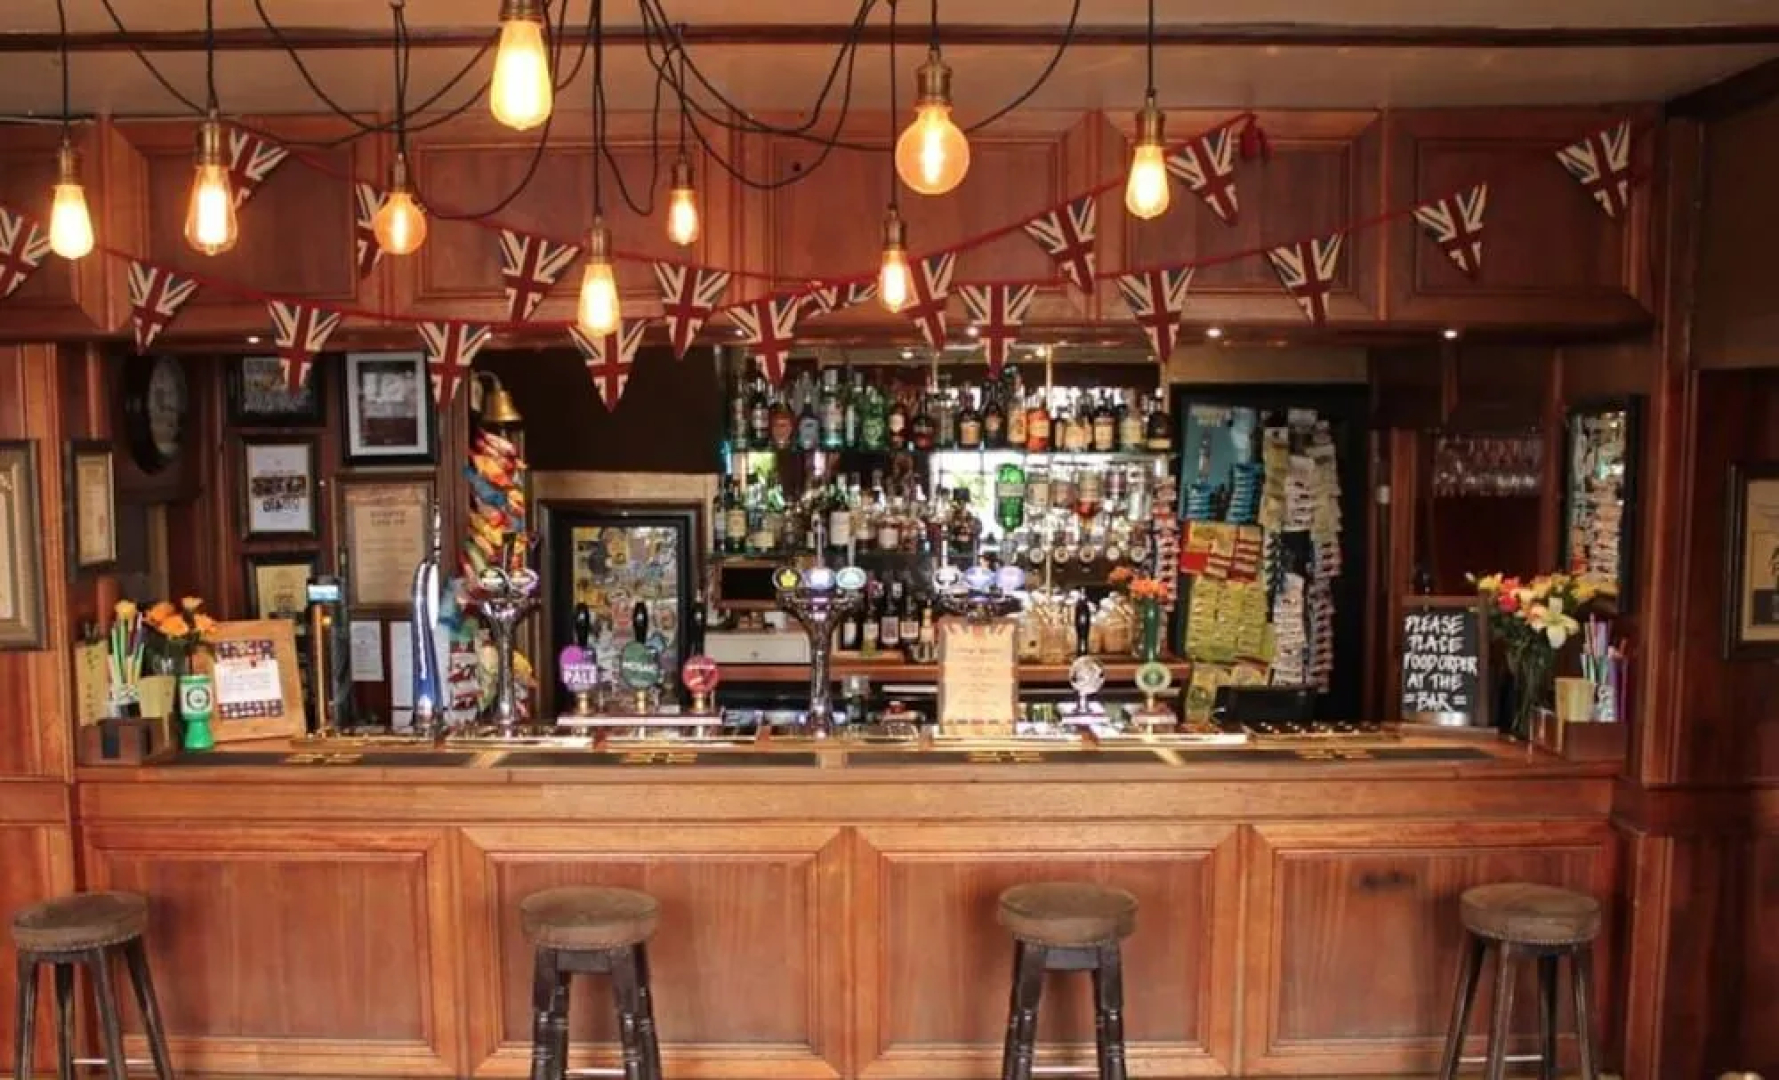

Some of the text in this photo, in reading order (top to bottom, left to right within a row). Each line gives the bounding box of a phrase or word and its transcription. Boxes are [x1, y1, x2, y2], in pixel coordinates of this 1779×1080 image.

[1405, 614, 1464, 634] PLEASE
[1408, 635, 1466, 653] PLACE
[1407, 672, 1463, 691] AT THE
